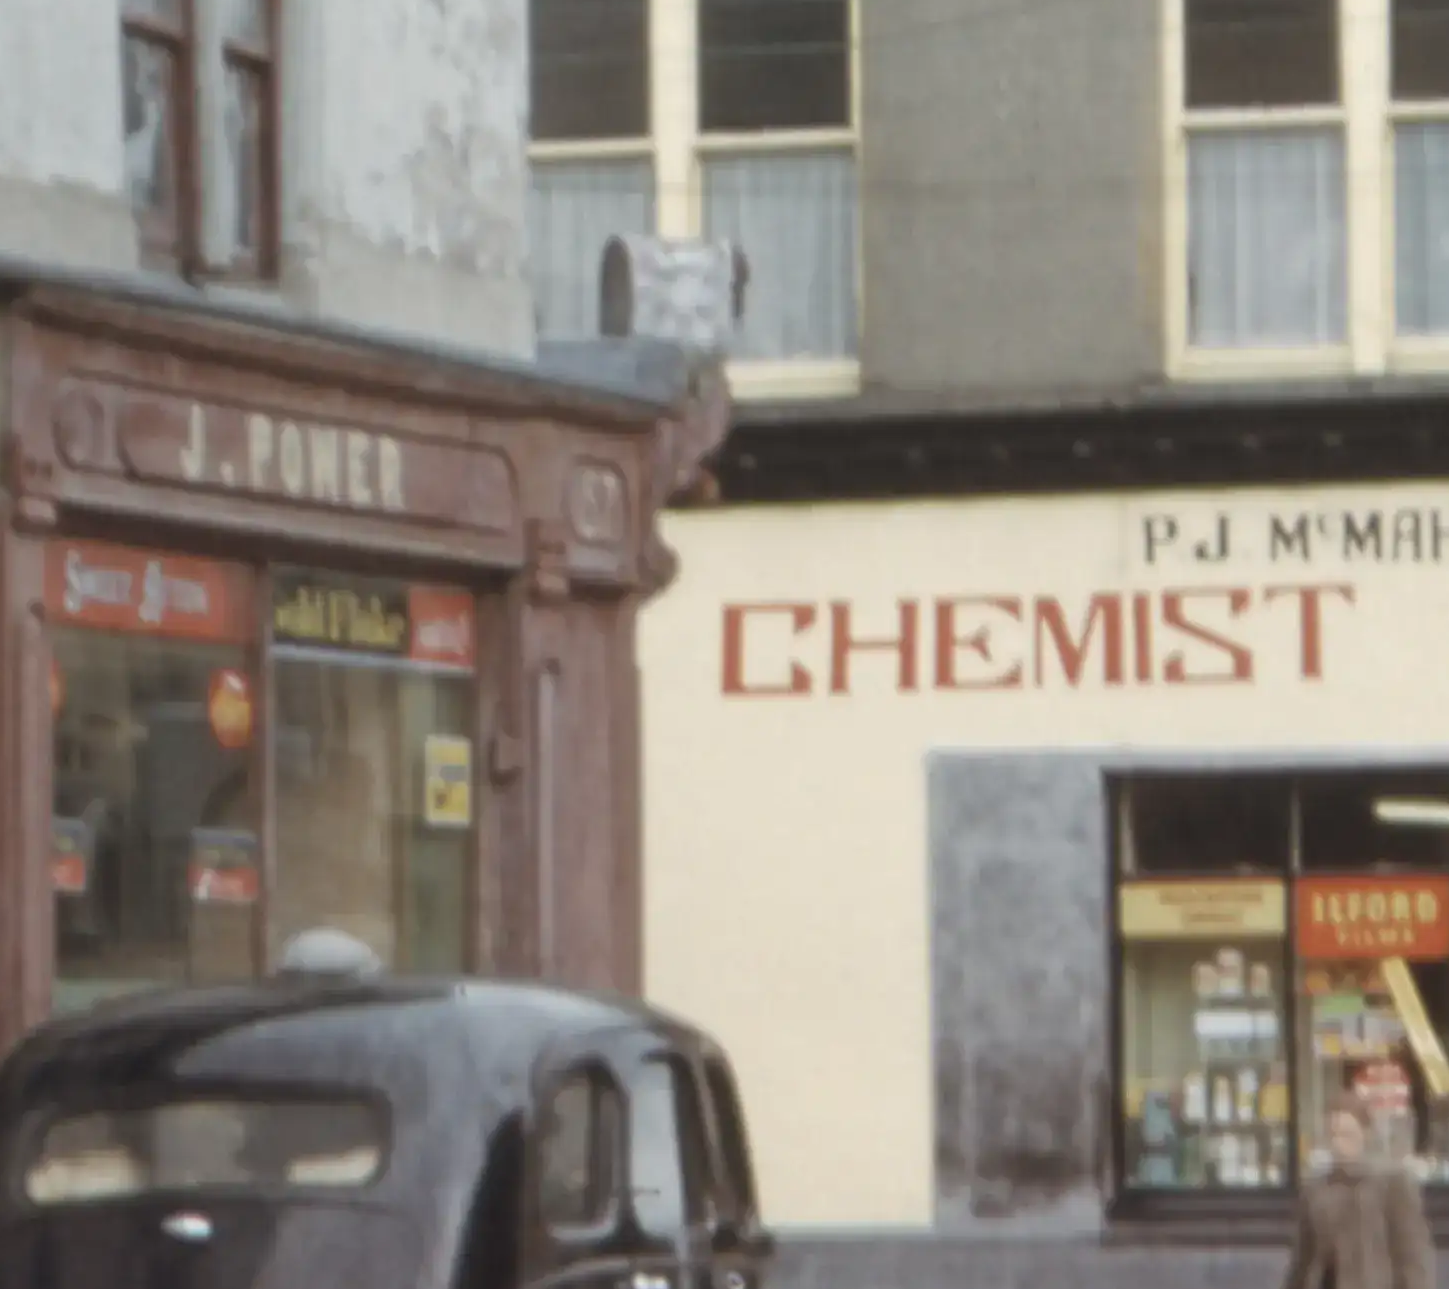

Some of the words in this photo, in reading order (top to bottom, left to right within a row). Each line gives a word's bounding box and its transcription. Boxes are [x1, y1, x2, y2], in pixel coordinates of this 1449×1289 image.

[249, 412, 406, 513] POWER
[720, 582, 1356, 698] CHEMIST
[1311, 889, 1438, 924] ILFORD
